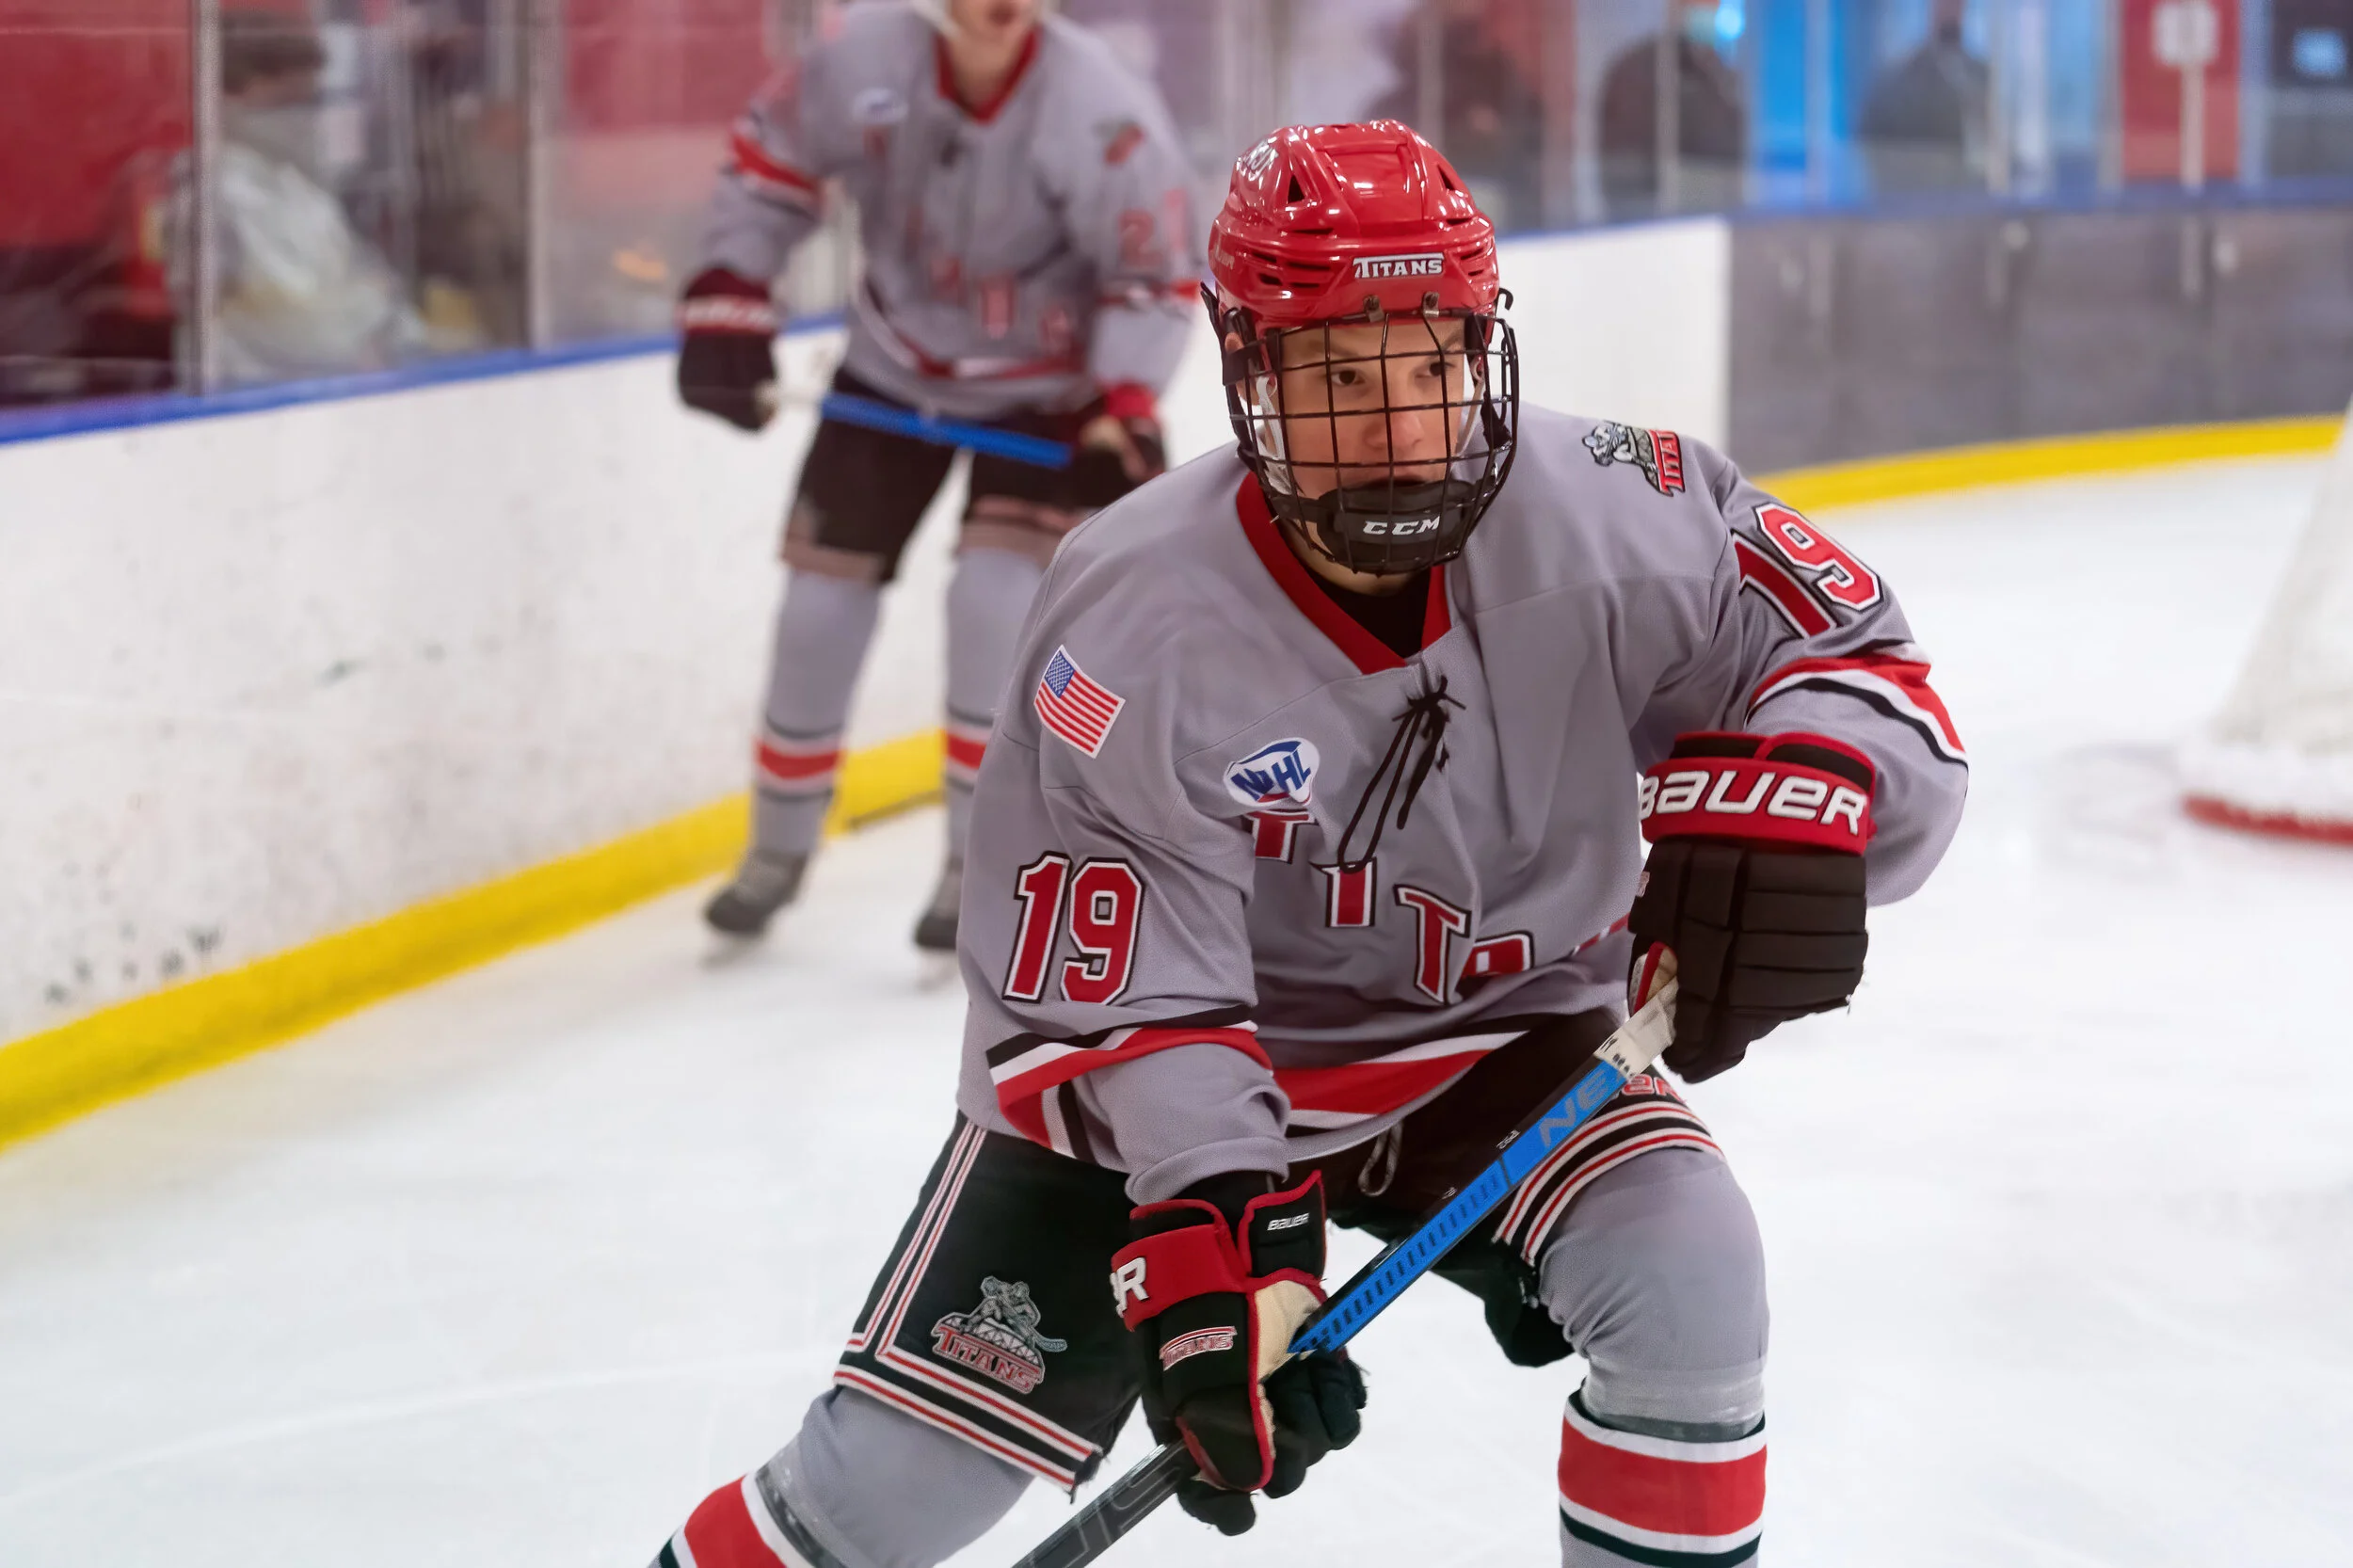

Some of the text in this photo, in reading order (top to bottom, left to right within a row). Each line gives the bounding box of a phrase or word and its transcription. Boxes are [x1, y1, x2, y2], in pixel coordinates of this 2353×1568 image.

[1353, 252, 1444, 279] TITANS
[1363, 516, 1440, 536] CCM
[1730, 501, 1883, 639] 19
[1001, 850, 1146, 1005] 19
[1539, 1069, 1625, 1148] NE
[933, 1325, 1042, 1393] TITANS
